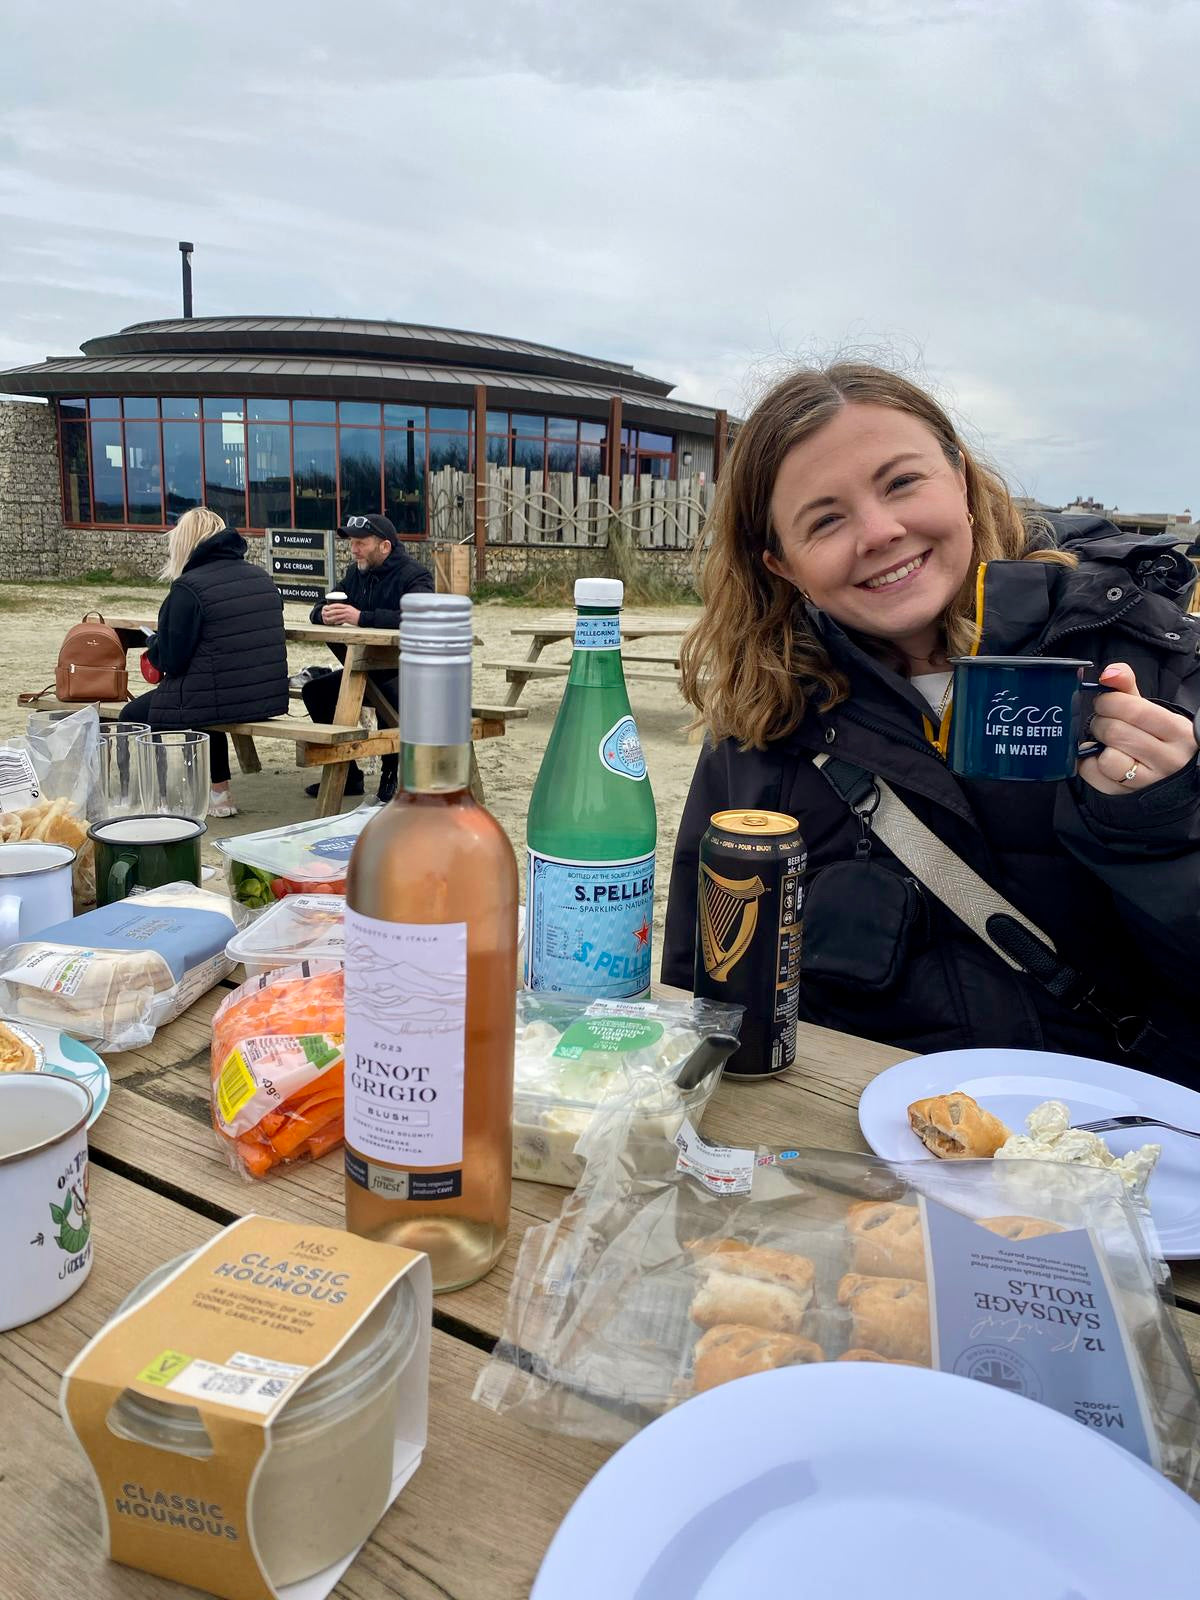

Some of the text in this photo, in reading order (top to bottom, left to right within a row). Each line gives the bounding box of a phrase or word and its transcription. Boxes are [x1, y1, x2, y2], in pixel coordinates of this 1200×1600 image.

[283, 536, 313, 544] TAKEAWAY
[292, 563, 314, 571] CREAMS
[282, 588, 319, 598] BEACH GOODS
[985, 722, 1063, 737] LIFE IS BETTER
[995, 743, 1048, 756] IN WATER
[738, 843, 752, 851] POUR
[787, 855, 800, 866] BEER
[568, 872, 591, 880] BOTTLED
[580, 903, 623, 913] SPARKLING
[373, 1040, 403, 1053] 2023
[355, 1053, 430, 1083] PINOT
[350, 1072, 438, 1103] GRIGIO
[367, 1106, 410, 1122] BLUSH
[294, 1240, 339, 1258] M&S
[970, 1260, 989, 1270] bred
[1025, 1255, 1061, 1266] enriched
[1062, 1261, 1087, 1272] butter
[240, 1252, 350, 1287] CLASSIC
[990, 1264, 1022, 1275] outdoor
[1023, 1268, 1051, 1280] British
[1070, 1270, 1089, 1279] pork
[213, 1262, 348, 1305] HOUMOUS
[1007, 1279, 1097, 1310] ROLLS
[194, 1292, 316, 1328] COOKED CHICKPEAS WITH
[229, 1291, 279, 1308] AUTHENTIC
[279, 1304, 297, 1313] DIP
[298, 1308, 314, 1318] OF
[974, 1291, 1101, 1331] SAUSAGE
[224, 1310, 260, 1324] GARLIC
[270, 1322, 304, 1335] LEMON
[1083, 1336, 1106, 1352] 12
[1073, 1408, 1125, 1430] M&S
[122, 1482, 224, 1521] CLASSIC
[115, 1498, 239, 1541] HOUMOUS
